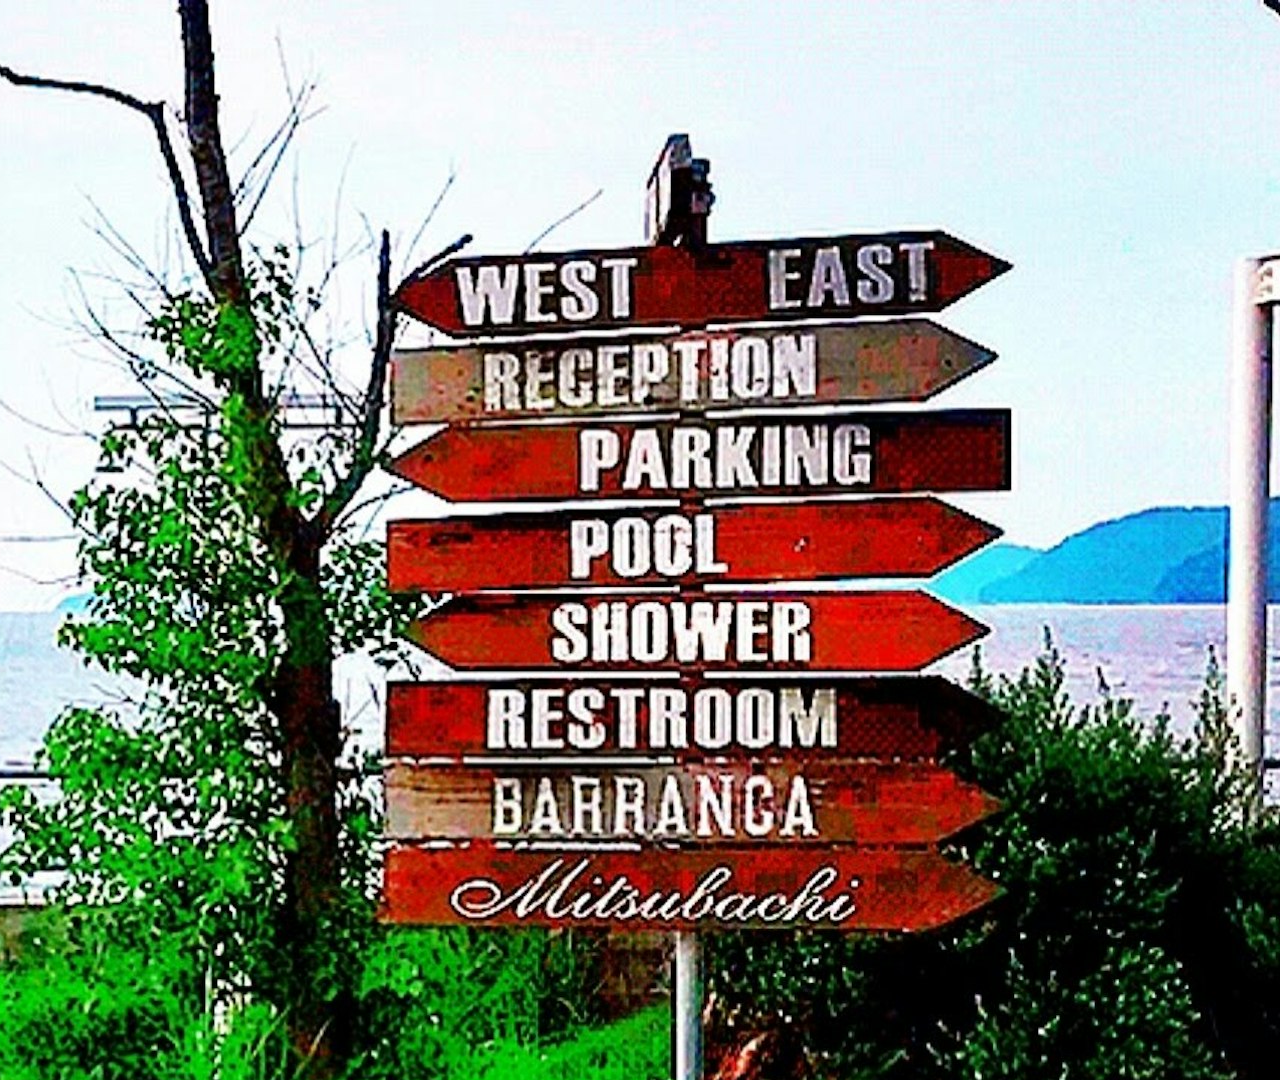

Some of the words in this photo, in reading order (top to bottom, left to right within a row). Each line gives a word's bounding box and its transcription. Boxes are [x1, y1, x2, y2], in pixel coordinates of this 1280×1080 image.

[455, 258, 638, 326] WEST
[768, 241, 935, 310] EAST
[483, 335, 818, 411] RECEPTION
[579, 425, 871, 491] PARKING
[570, 514, 728, 578] POOL
[551, 601, 811, 662] SHOWER
[486, 688, 837, 750] RESTROOM
[492, 776, 819, 837] BARRANCA
[450, 857, 858, 922] Mitsubachi
